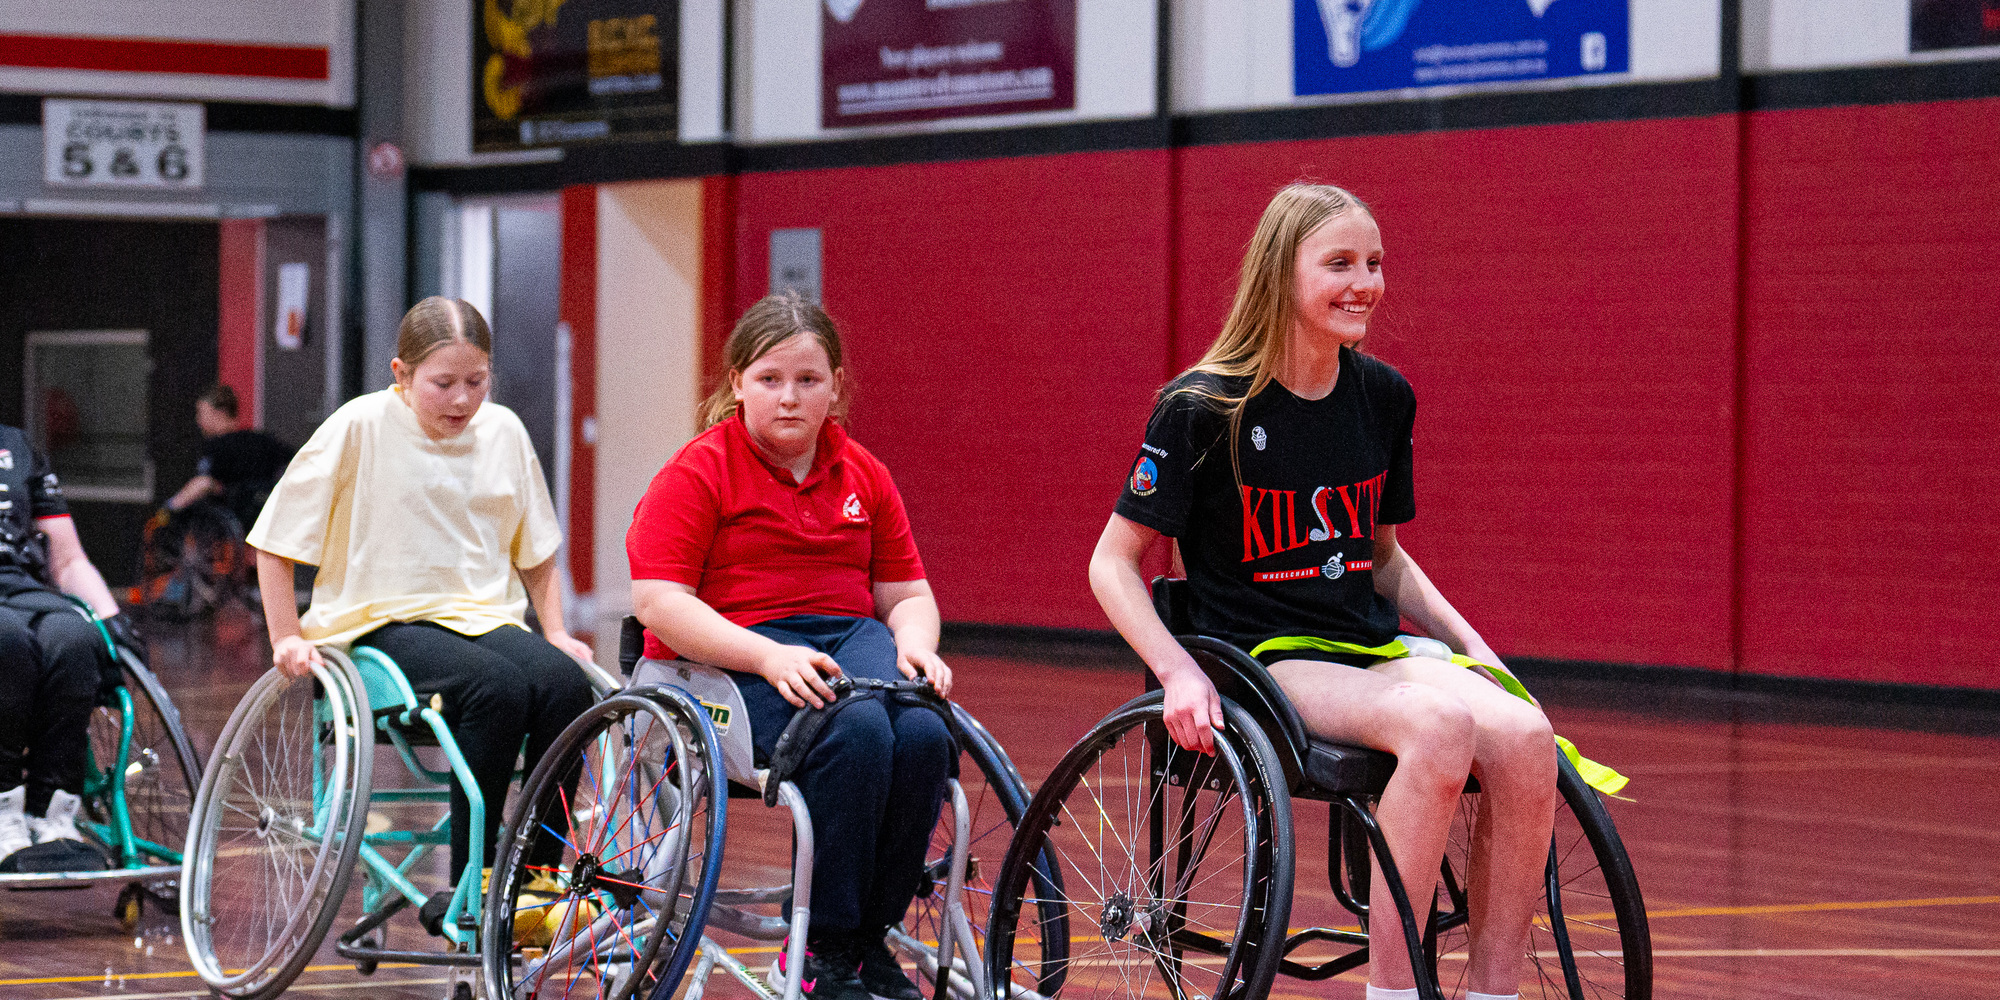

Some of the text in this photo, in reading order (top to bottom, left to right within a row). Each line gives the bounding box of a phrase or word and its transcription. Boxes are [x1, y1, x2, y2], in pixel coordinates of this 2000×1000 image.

[63, 141, 189, 180] 5 & 6
[1262, 569, 1314, 580] WHEELCHAIR
